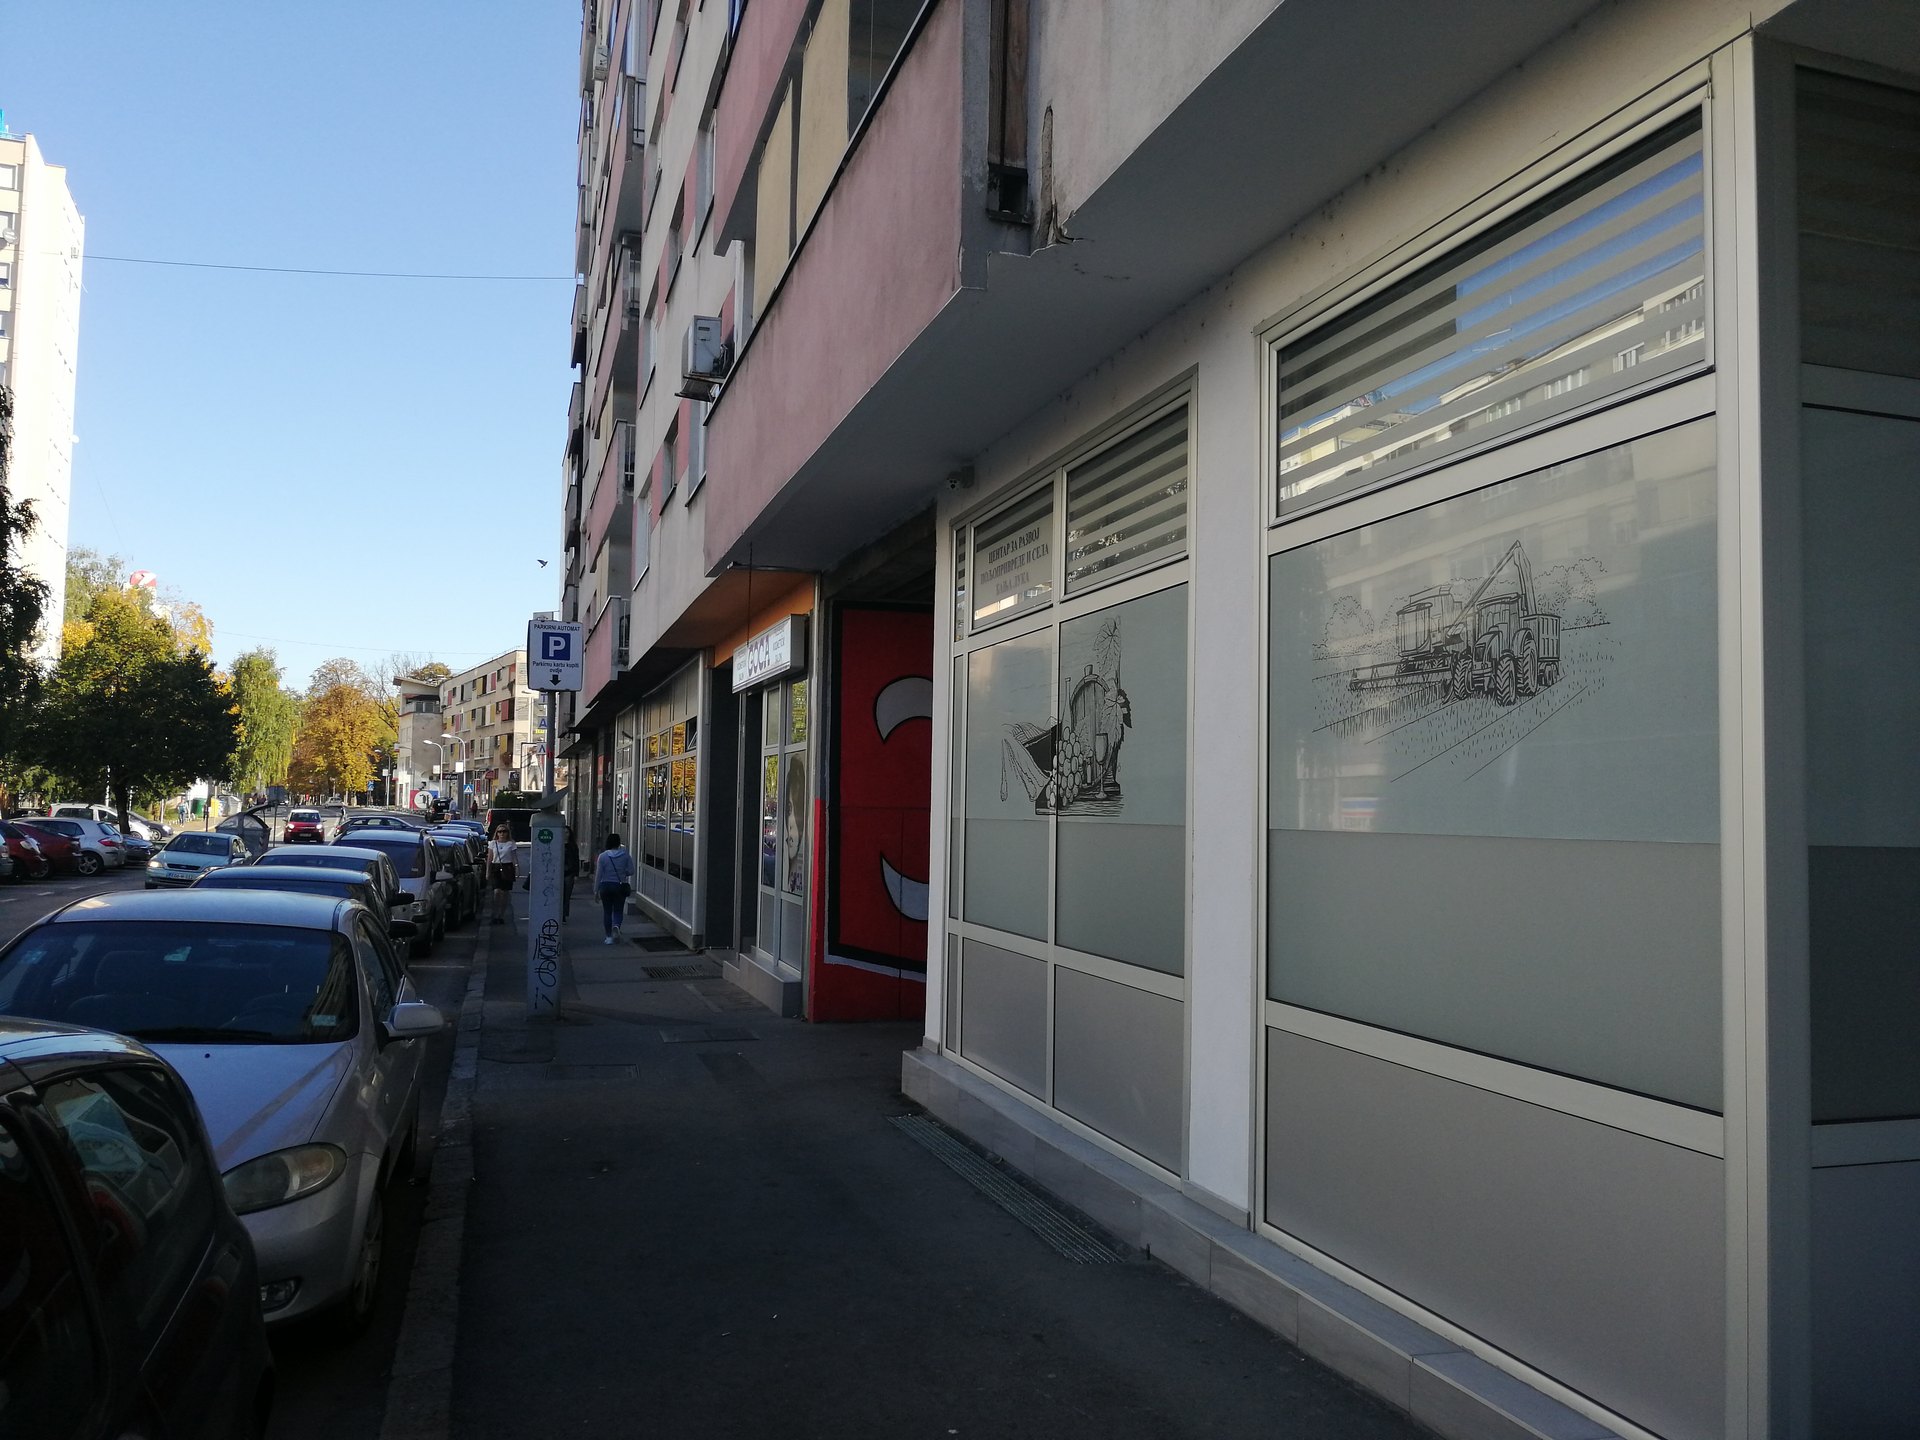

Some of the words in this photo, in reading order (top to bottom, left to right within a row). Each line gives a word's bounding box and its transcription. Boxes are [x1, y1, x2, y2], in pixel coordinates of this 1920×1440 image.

[988, 543, 1010, 564] ЦЕНТАР
[1010, 539, 1018, 553] ЗА
[1018, 527, 1040, 549] РАЗВОЈ
[1031, 543, 1049, 561] СЕЛА
[549, 636, 566, 657] P
